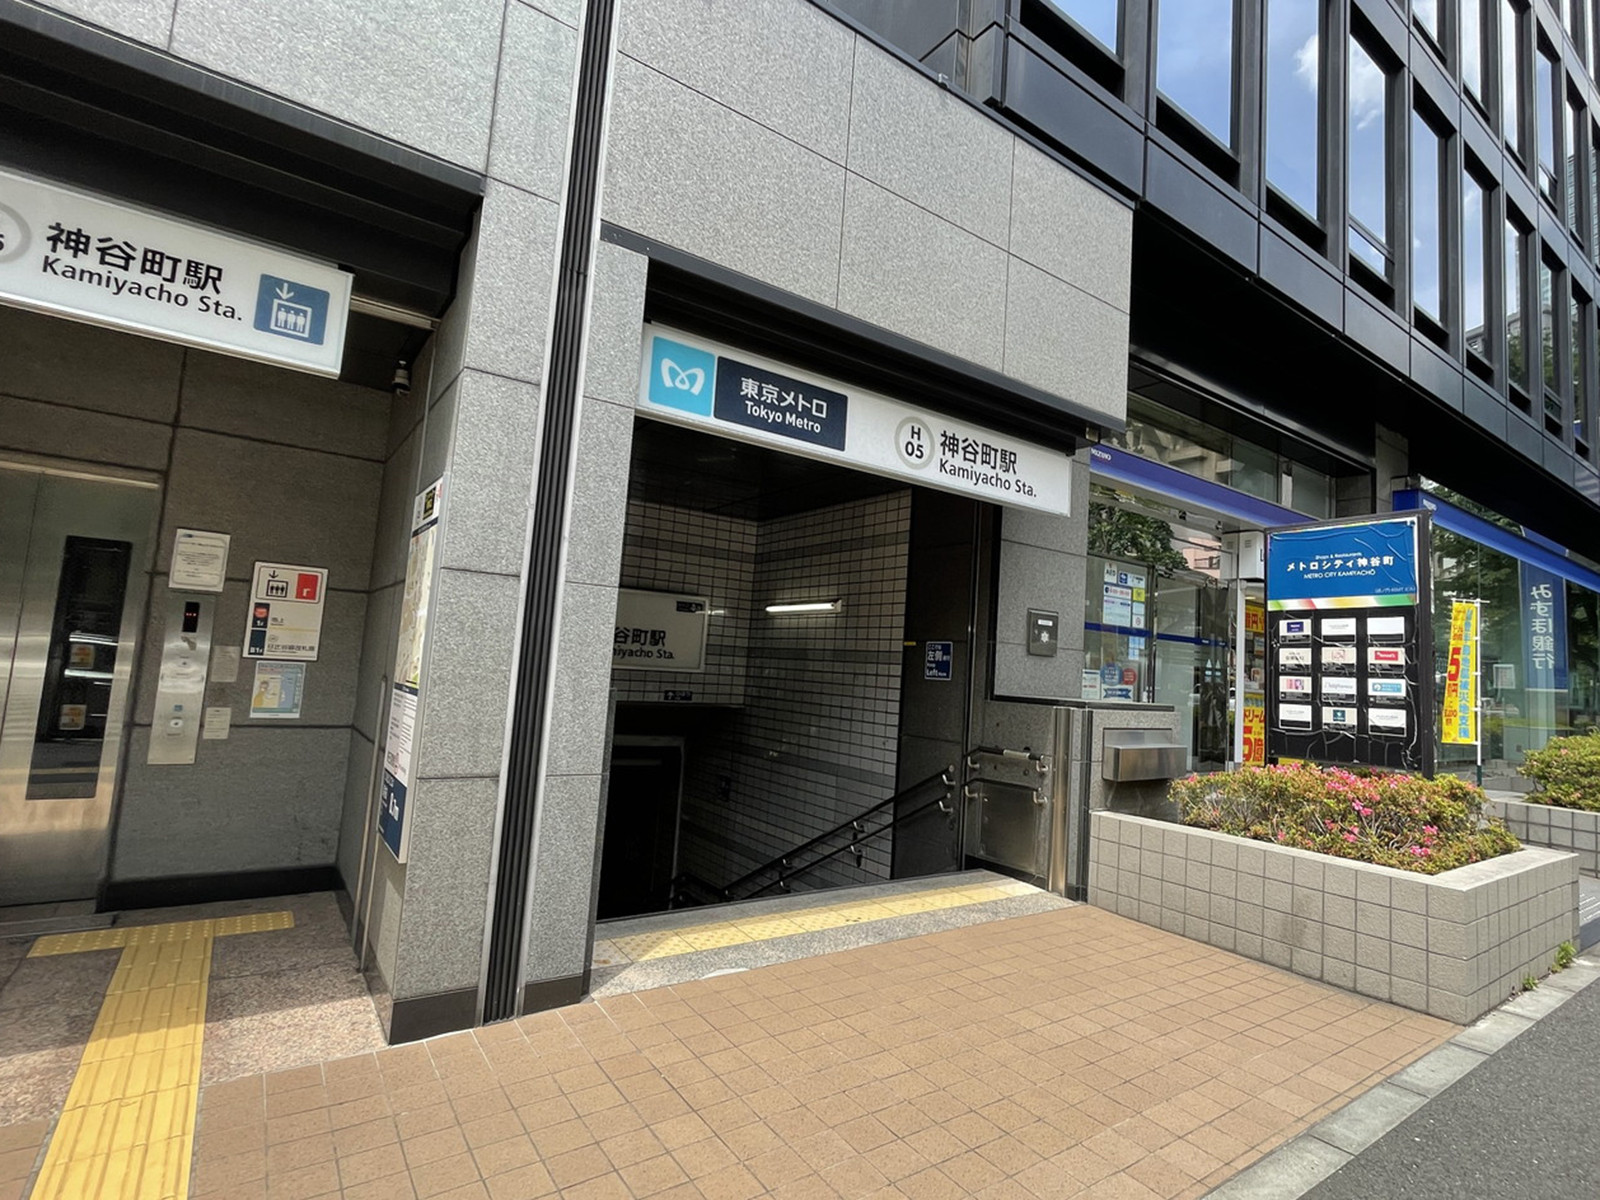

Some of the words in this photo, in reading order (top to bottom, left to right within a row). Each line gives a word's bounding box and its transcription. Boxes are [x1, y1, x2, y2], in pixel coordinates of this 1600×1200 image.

[46, 222, 223, 294] 神谷町駅
[42, 255, 188, 308] Kamiyacho
[198, 296, 243, 321] Sta.
[740, 376, 827, 419] 東京メトロ
[745, 400, 783, 423] Tokyo
[785, 411, 821, 433] Metro
[910, 425, 921, 441] H
[905, 441, 924, 459] 05
[940, 430, 1017, 475] 神谷町駅
[939, 458, 1010, 491] Kamiyacho
[1014, 479, 1037, 498] Sta.
[1286, 555, 1394, 572] メトロシティ神谷町
[656, 649, 675, 659] Sta.
[1447, 647, 1461, 682] 5
